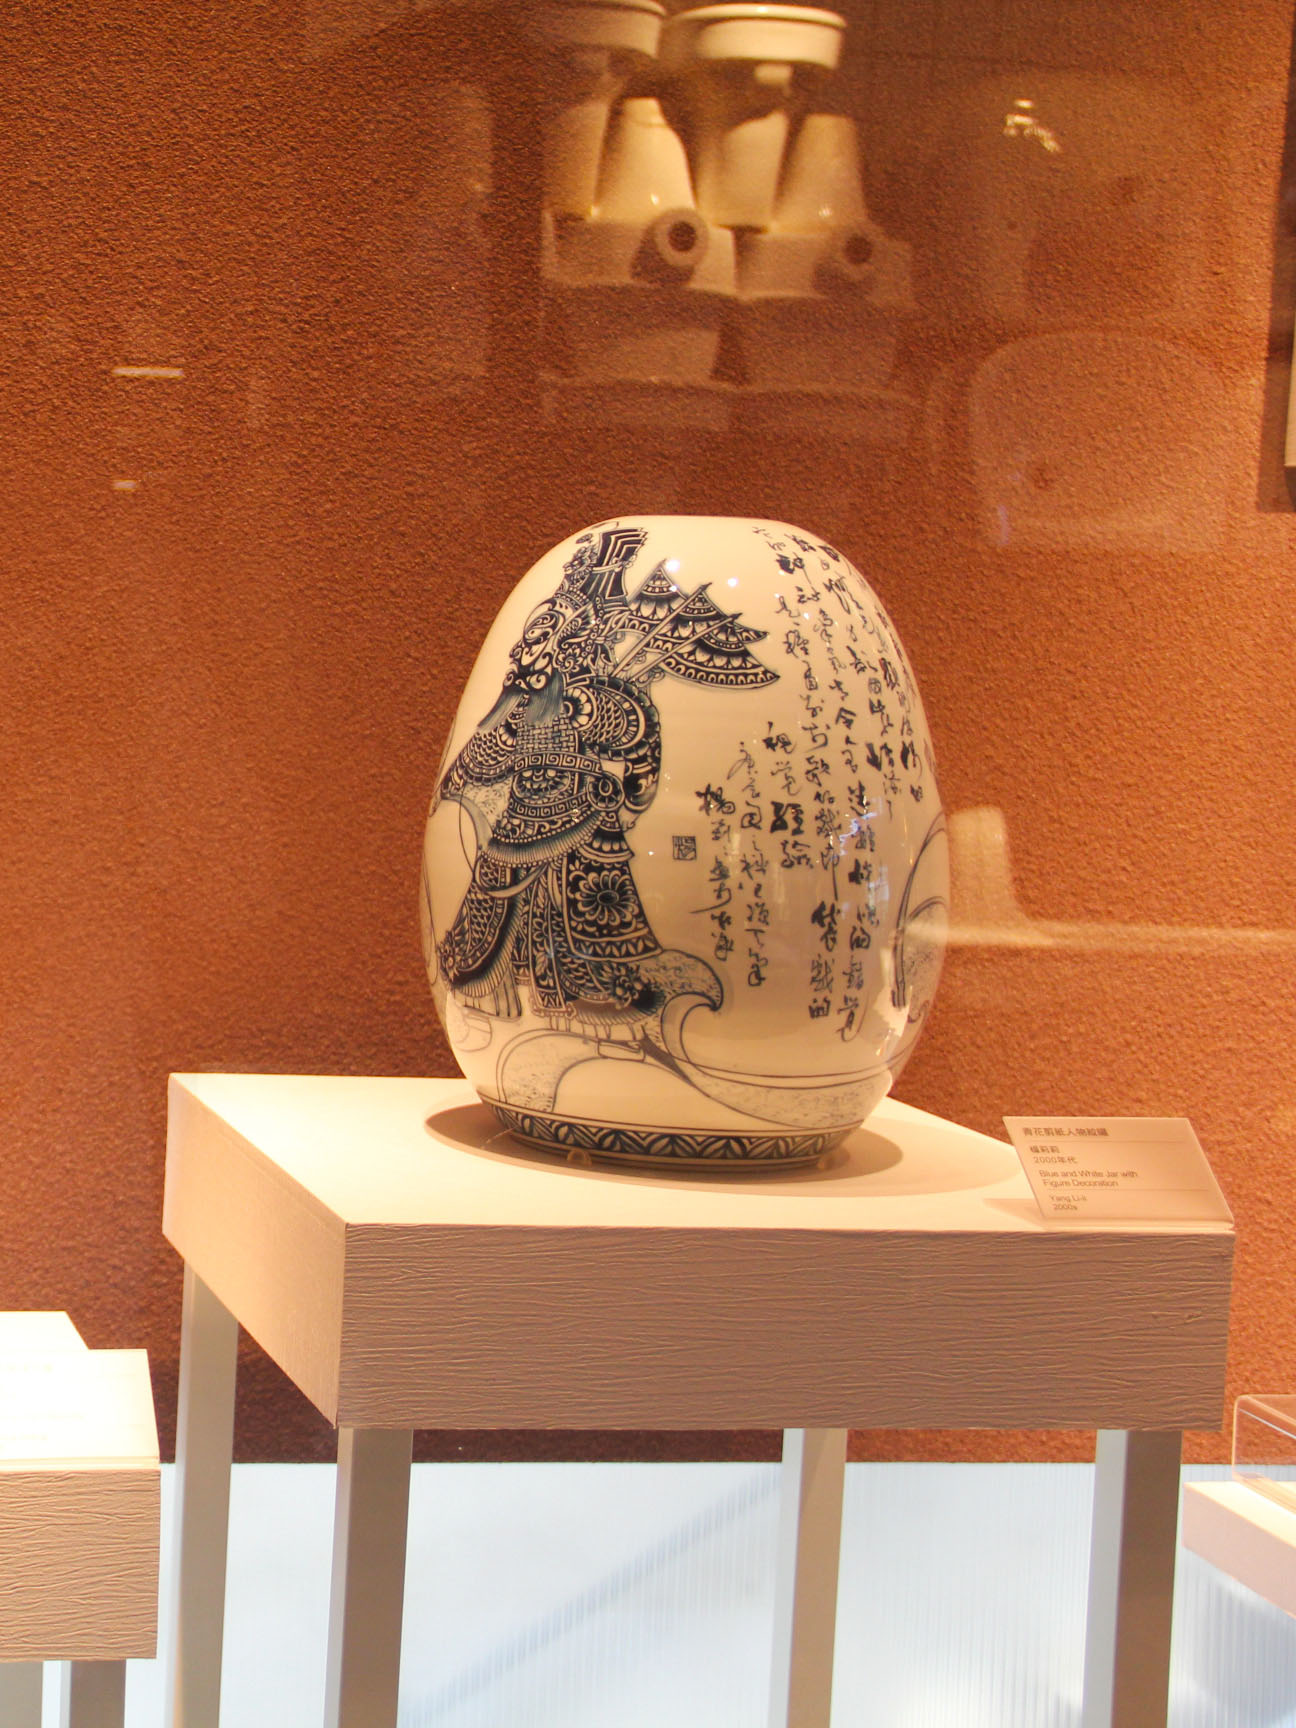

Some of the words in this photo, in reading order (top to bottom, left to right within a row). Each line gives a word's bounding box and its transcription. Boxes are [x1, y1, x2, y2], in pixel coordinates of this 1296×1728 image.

[1039, 1169, 1058, 1178] Blue
[1060, 1169, 1078, 1178] and
[1079, 1169, 1104, 1178] White
[1106, 1169, 1119, 1178] Jar
[1121, 1169, 1138, 1178] with
[1043, 1178, 1071, 1188] Figure
[1072, 1178, 1119, 1187] Decoration
